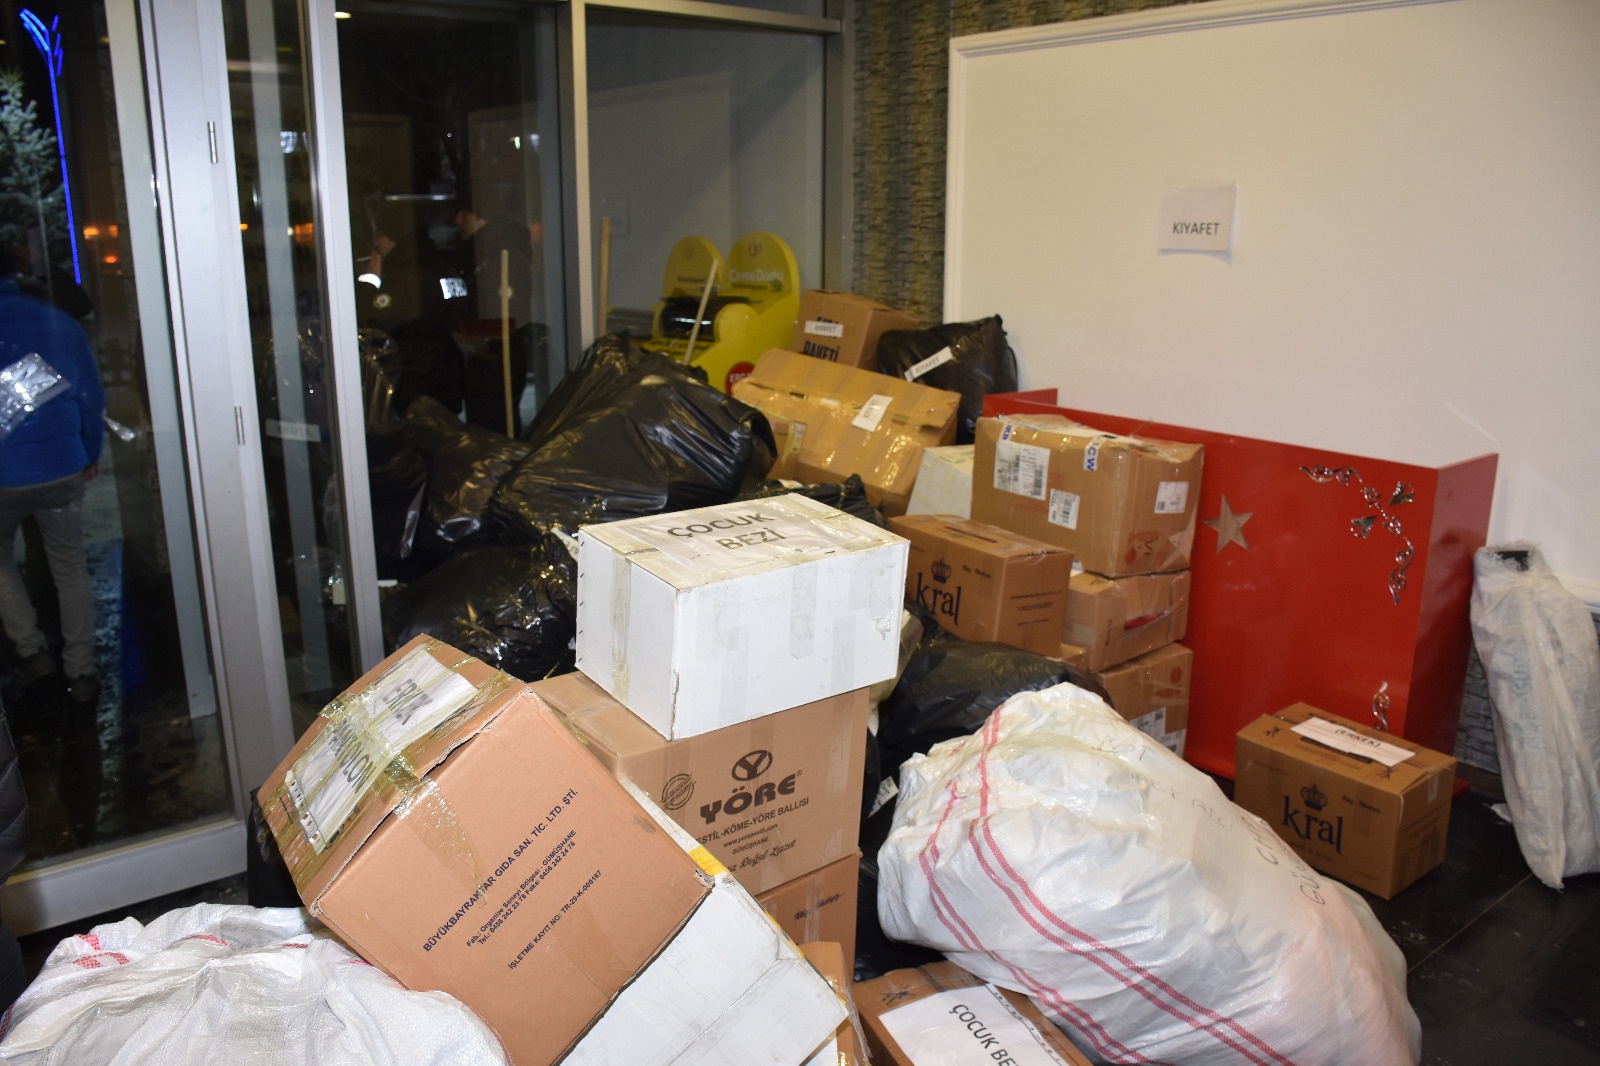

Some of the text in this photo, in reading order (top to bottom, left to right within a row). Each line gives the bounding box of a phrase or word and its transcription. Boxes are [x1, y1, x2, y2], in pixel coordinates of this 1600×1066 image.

[1172, 222, 1221, 235] KIYAFET
[667, 513, 775, 538] ÇOCUK
[715, 527, 786, 549] BEZİ
[915, 572, 962, 626] kral
[695, 796, 809, 845] ESTİL-KÖME-YÖRE BALLISI
[700, 773, 797, 825] YÖRE
[1281, 796, 1344, 855] kral
[495, 856, 516, 877] GIDA
[513, 838, 534, 858] SAN.
[531, 822, 548, 838] TİC.
[546, 806, 564, 822] LTD.
[562, 788, 578, 805] ŞTİ.
[539, 865, 553, 880] 0456
[551, 855, 563, 868] 242
[480, 907, 504, 932] Organize
[502, 889, 521, 908] Sanayi
[519, 868, 541, 890] Bölgesi
[507, 941, 535, 970] İŞLETME
[533, 925, 551, 944] KAYIT
[550, 912, 563, 926] NO:
[949, 1004, 1021, 1066] ÇOCUK BE
